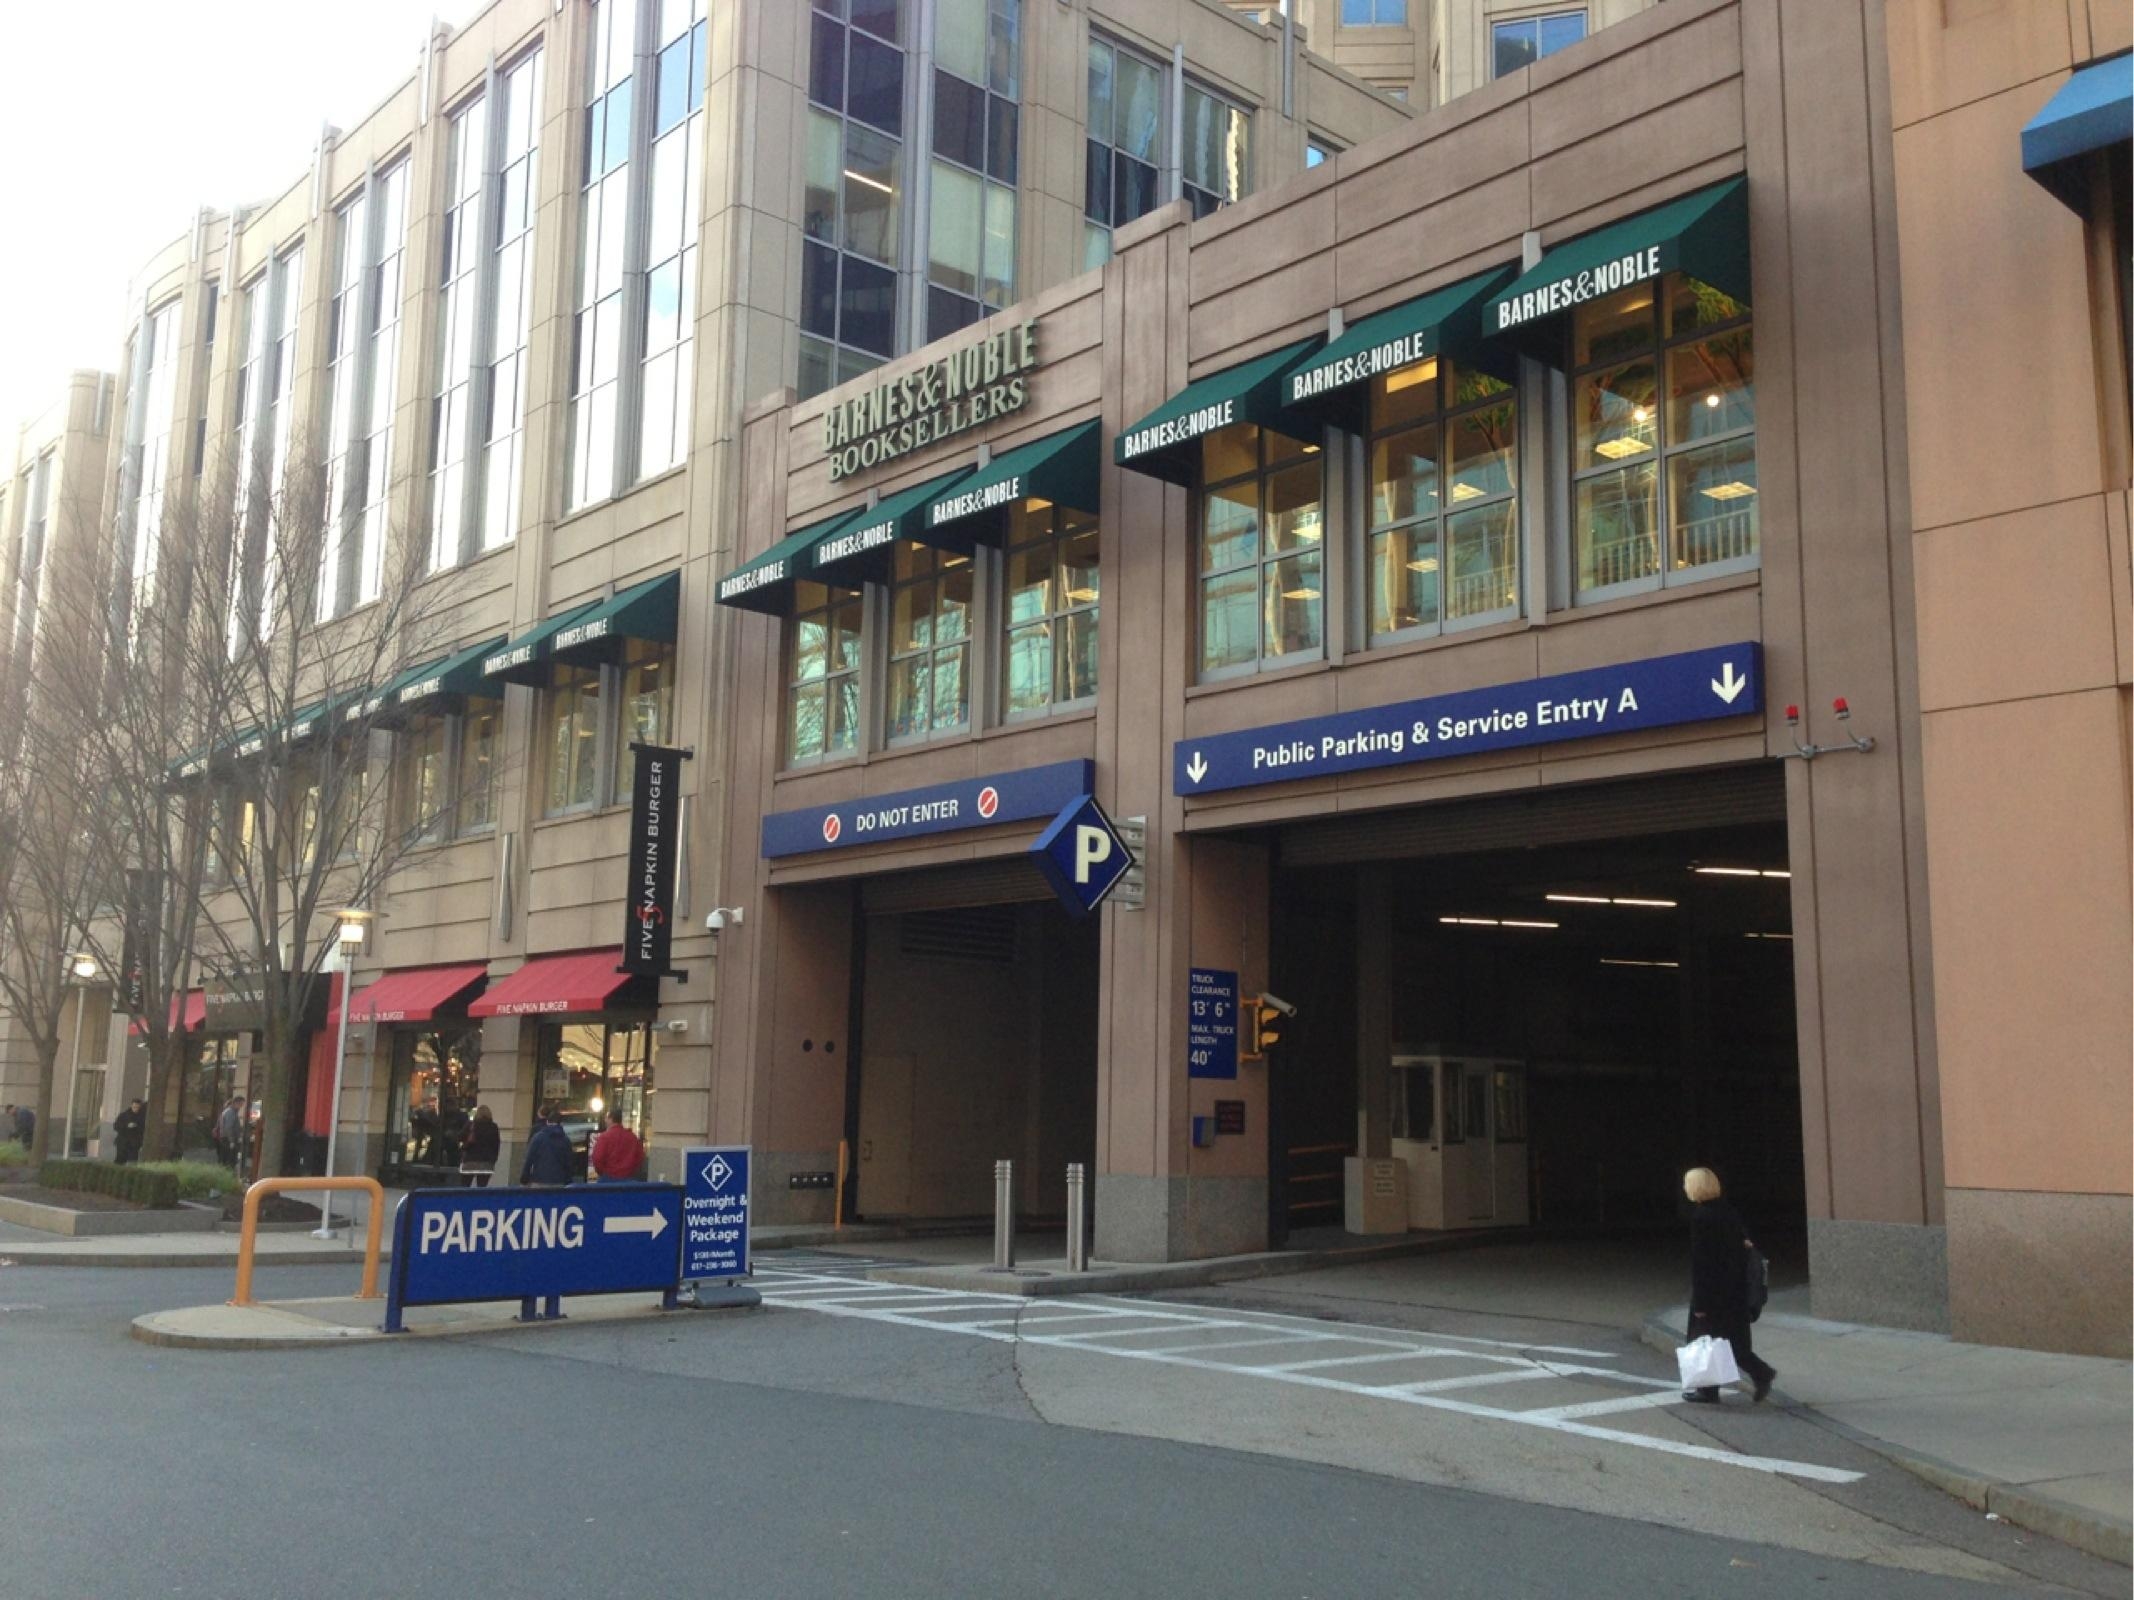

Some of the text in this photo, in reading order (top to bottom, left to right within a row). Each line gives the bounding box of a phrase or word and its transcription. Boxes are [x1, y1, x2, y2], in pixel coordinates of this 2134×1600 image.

[1498, 245, 1661, 330] BARNES&NOBLE
[1293, 332, 1424, 401] BARNES&NOBLE
[829, 377, 1026, 482] BOOKSELLERS
[1124, 400, 1234, 459] BARNES&NOBLE
[932, 477, 1019, 525] BARNES&NOBLE
[819, 521, 894, 564] BARNES&NOBLE
[721, 560, 784, 599] BARNES&NOBLE
[1253, 687, 1639, 769] Public Parking & Service Entry A
[856, 799, 960, 833] DO NOT ENTER
[641, 760, 663, 960] FIVE NAPKIN BURGER
[1075, 824, 1112, 884] P
[711, 1163, 724, 1183] P
[684, 1194, 747, 1211] Overnight &
[687, 1211, 744, 1227] Weekend
[420, 1206, 584, 1254] PARKING
[690, 1228, 739, 1243] Package
